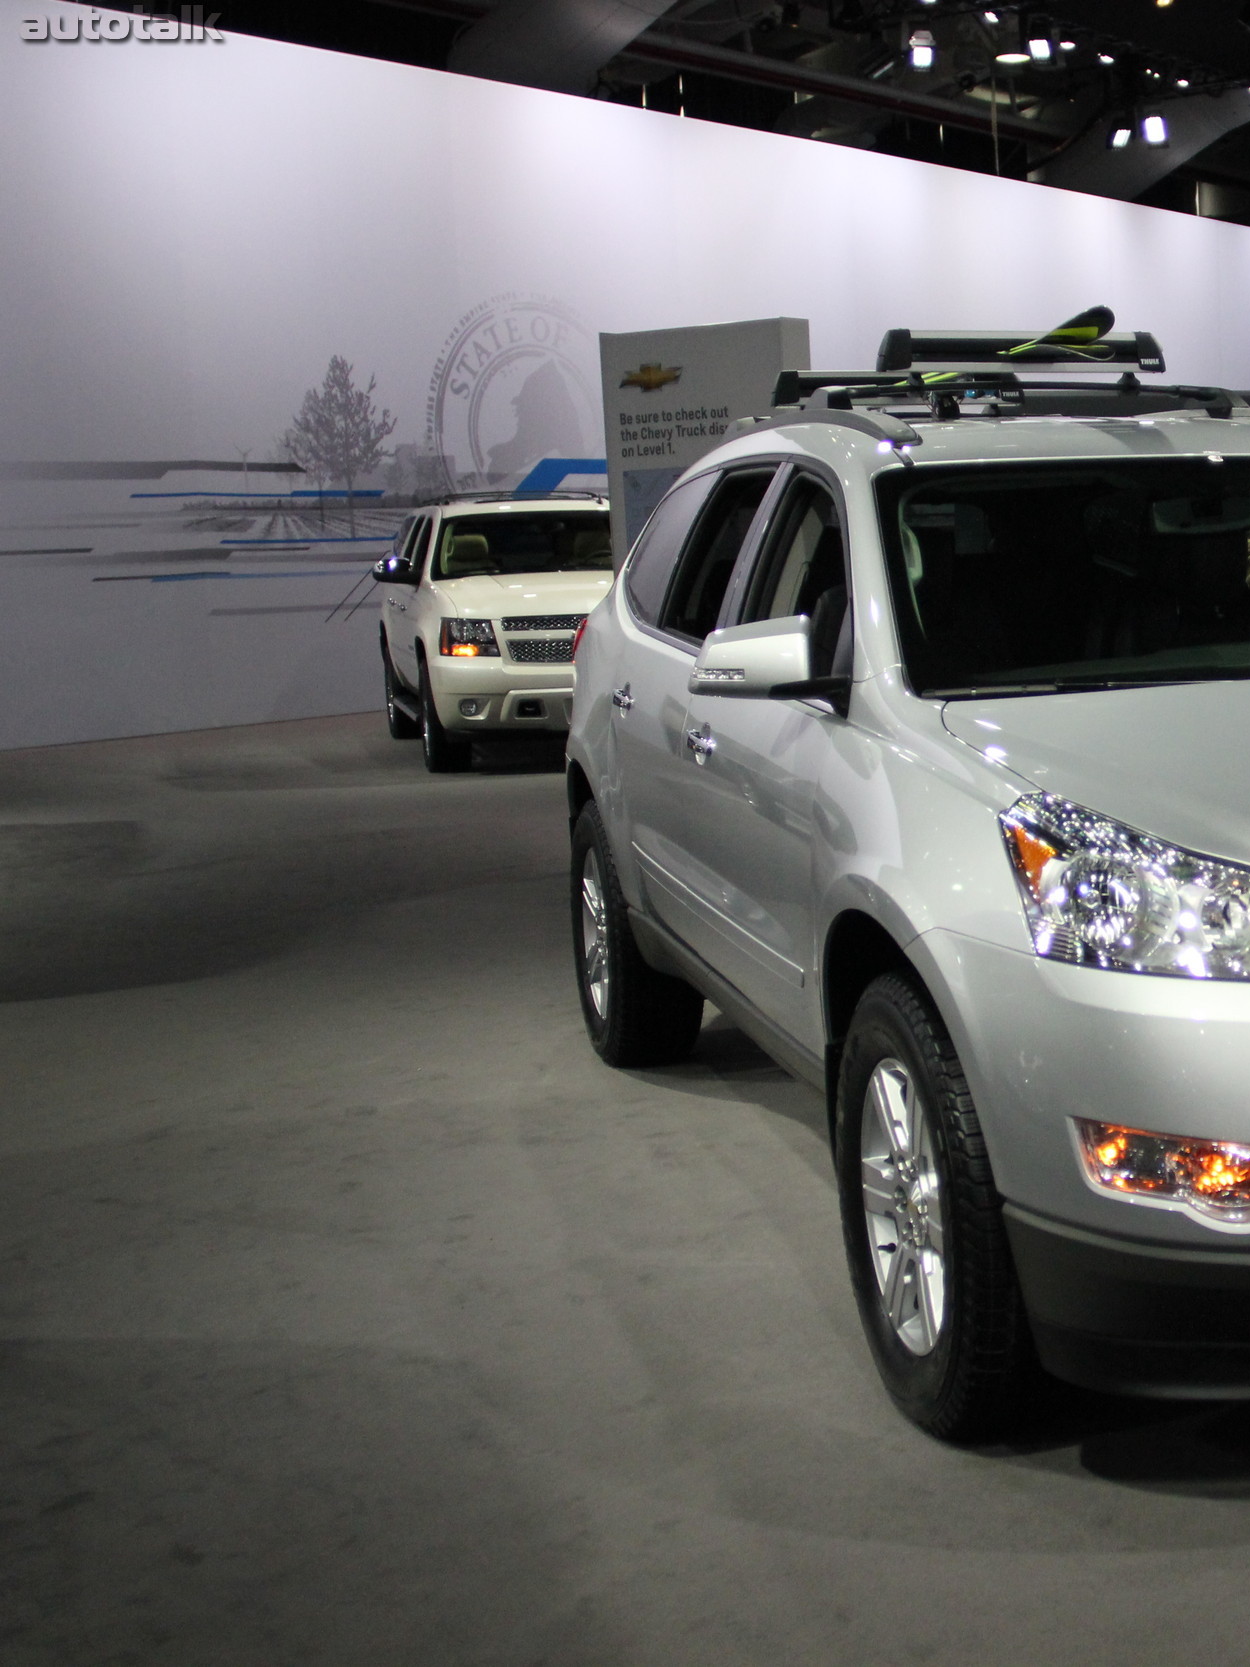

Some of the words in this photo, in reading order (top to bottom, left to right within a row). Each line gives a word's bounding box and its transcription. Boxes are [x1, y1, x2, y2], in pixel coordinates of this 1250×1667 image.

[450, 317, 521, 399] STATE
[530, 315, 568, 349] OF
[620, 412, 633, 426] Be
[635, 411, 659, 424] sure
[661, 409, 673, 423] to
[675, 407, 708, 421] check
[710, 406, 728, 419] out
[621, 429, 638, 442] the
[640, 426, 673, 441] Chevy
[676, 423, 706, 436] Truck
[709, 421, 728, 435] dis
[621, 446, 635, 458] on
[637, 442, 664, 457] Level
[667, 443, 675, 454] 1.
